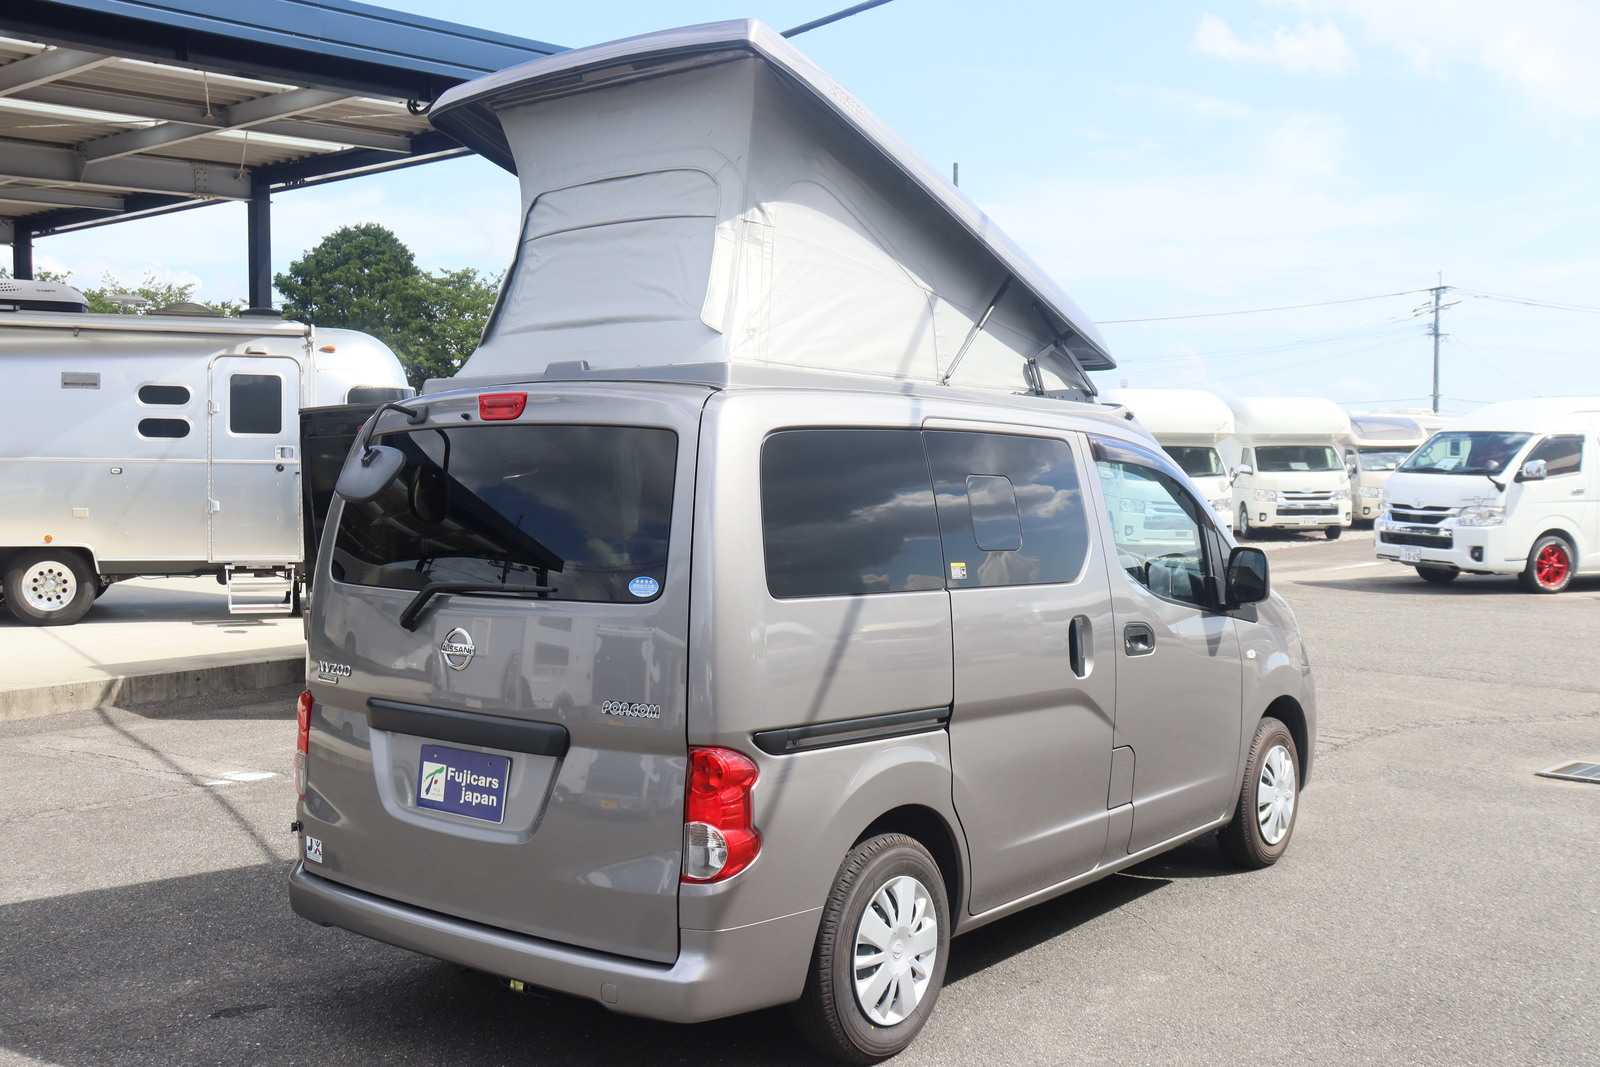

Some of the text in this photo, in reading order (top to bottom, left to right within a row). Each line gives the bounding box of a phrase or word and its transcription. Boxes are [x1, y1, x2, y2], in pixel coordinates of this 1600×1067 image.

[441, 643, 472, 656] NISSAN
[447, 767, 499, 789] Fujicars
[460, 787, 497, 807] japan
